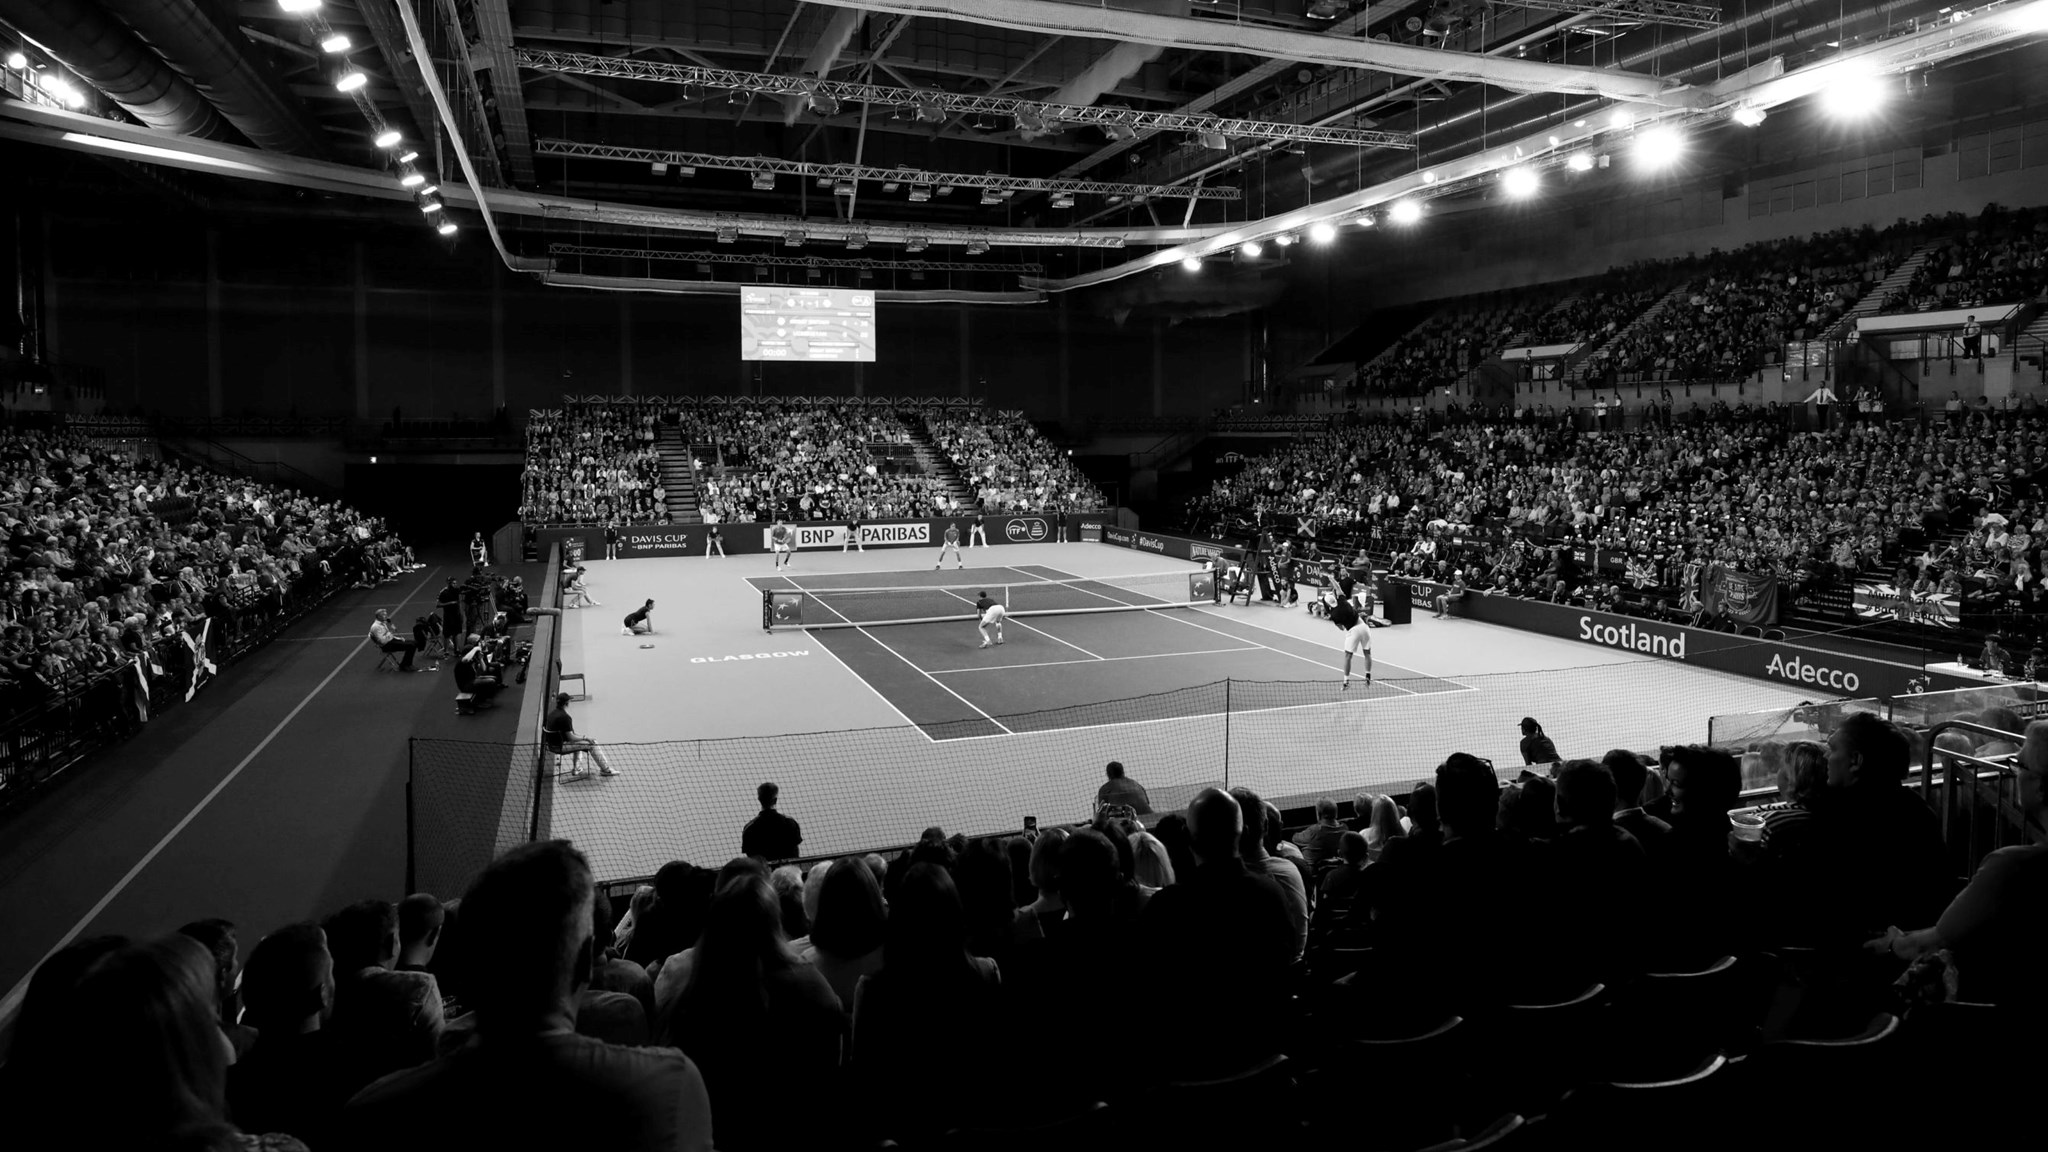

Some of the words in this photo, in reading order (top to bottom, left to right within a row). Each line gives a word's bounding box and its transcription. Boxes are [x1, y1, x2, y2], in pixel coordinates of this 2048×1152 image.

[631, 535, 662, 544] DAVIS
[664, 534, 687, 542] CUP
[801, 529, 835, 544] BNP
[862, 526, 929, 542] PARIBAS
[1139, 536, 1164, 552] #DavisCup
[1610, 556, 1623, 564] GBR
[1268, 556, 1280, 583] Adecco
[1411, 583, 1433, 597] CUP
[1579, 616, 1686, 659] Scotland
[690, 650, 809, 663] GLASGOW
[1765, 653, 1859, 692] Adecco
